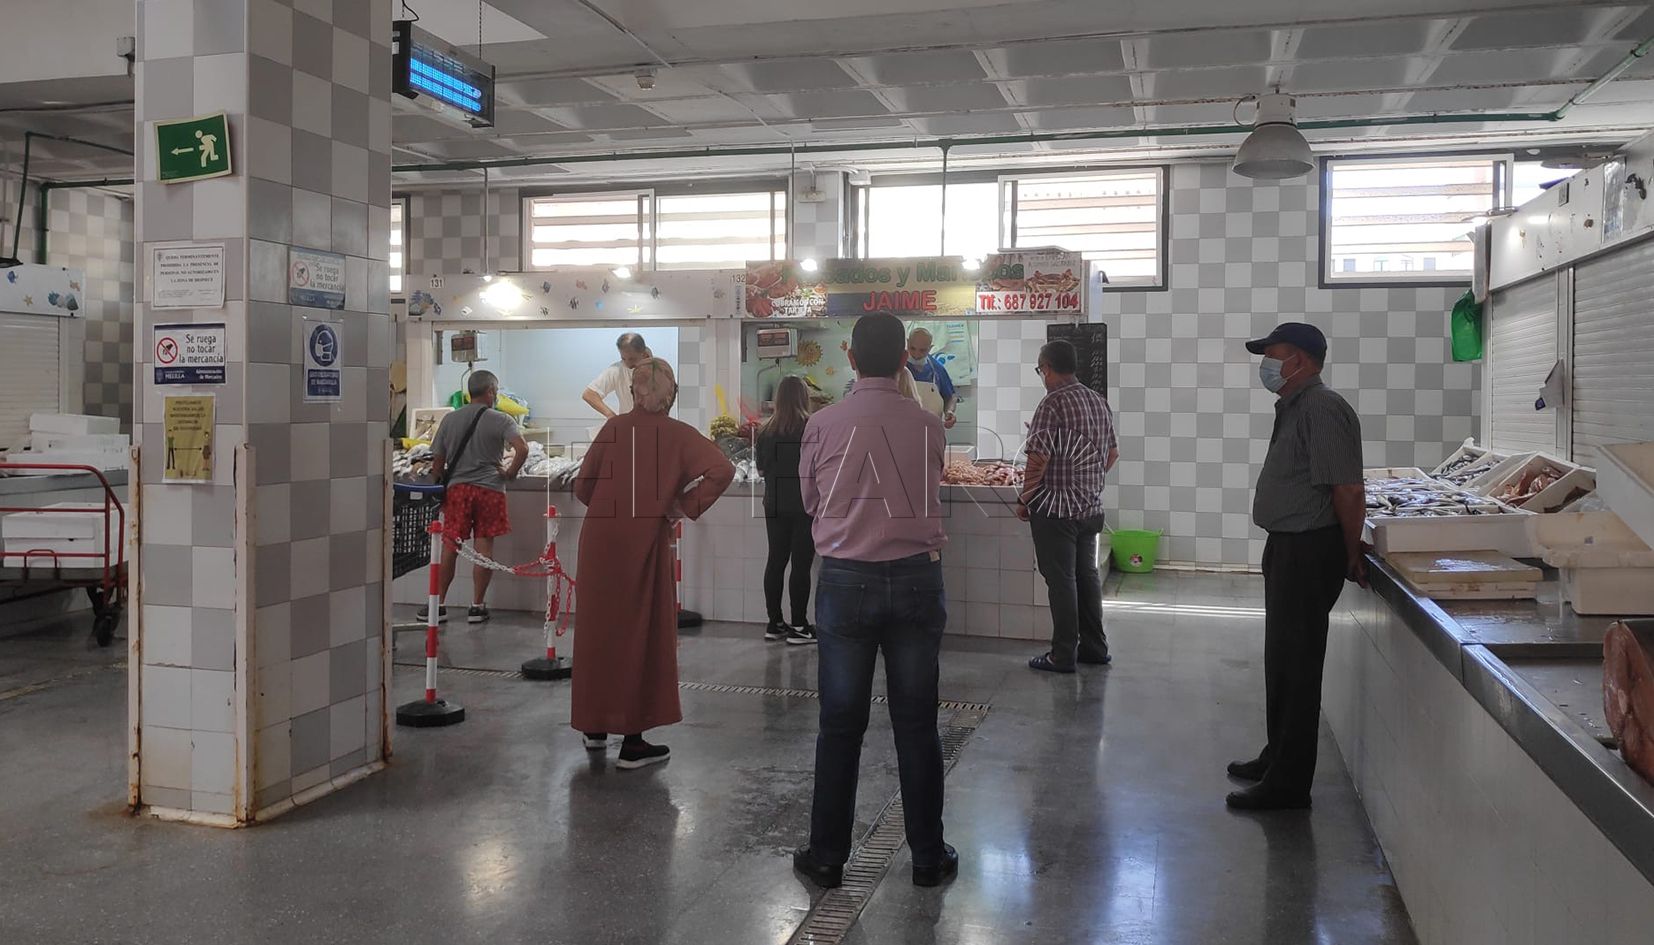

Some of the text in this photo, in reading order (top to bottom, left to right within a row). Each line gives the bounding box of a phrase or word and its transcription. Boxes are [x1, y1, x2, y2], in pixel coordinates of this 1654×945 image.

[732, 274, 746, 283] 132
[896, 266, 910, 287] y
[431, 279, 443, 288] 131
[863, 290, 937, 312] JAIME
[1004, 293, 1027, 310] 687
[1055, 293, 1079, 310] 104
[185, 333, 217, 345] Se ruega
[186, 344, 216, 353] no tocar
[179, 352, 224, 363] la mercancía
